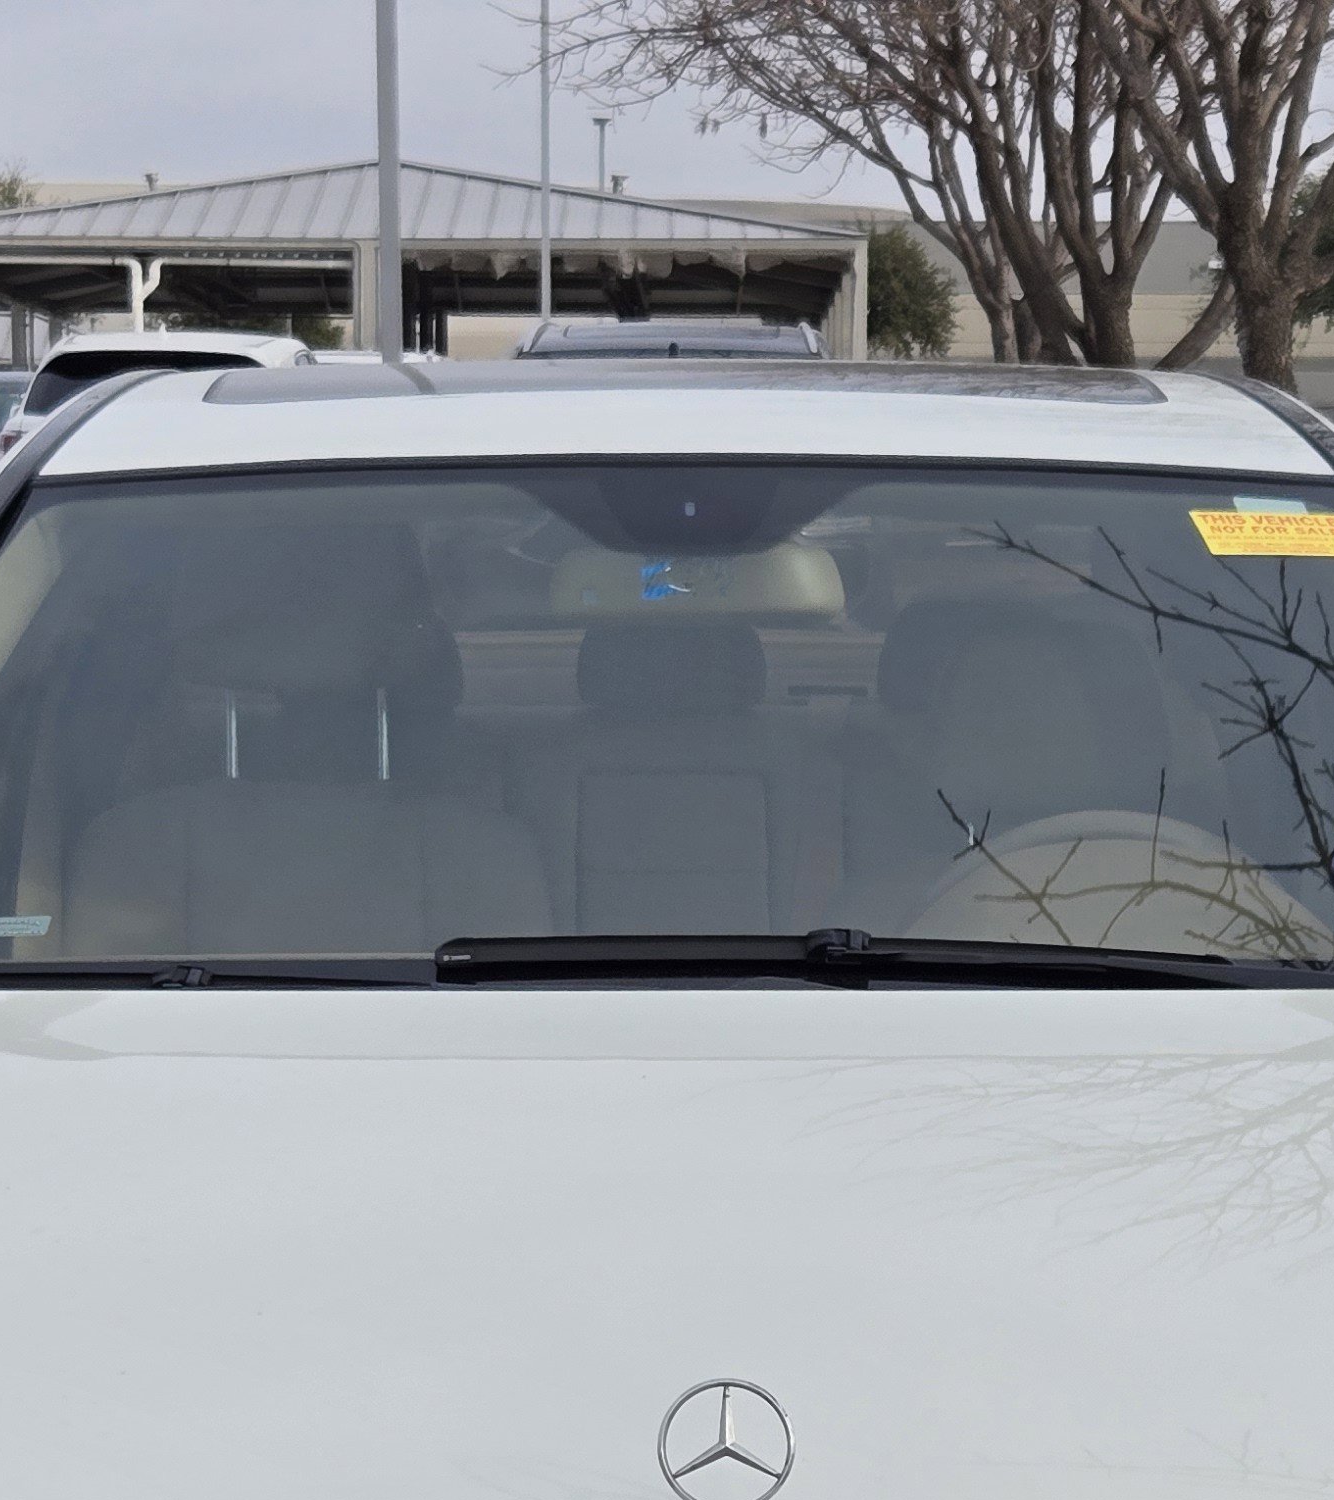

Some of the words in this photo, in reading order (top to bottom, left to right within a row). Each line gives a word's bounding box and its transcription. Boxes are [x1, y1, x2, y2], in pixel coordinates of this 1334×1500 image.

[1198, 514, 1247, 525] THIS
[1209, 525, 1245, 535] NOT
[1251, 525, 1288, 535] FOR
